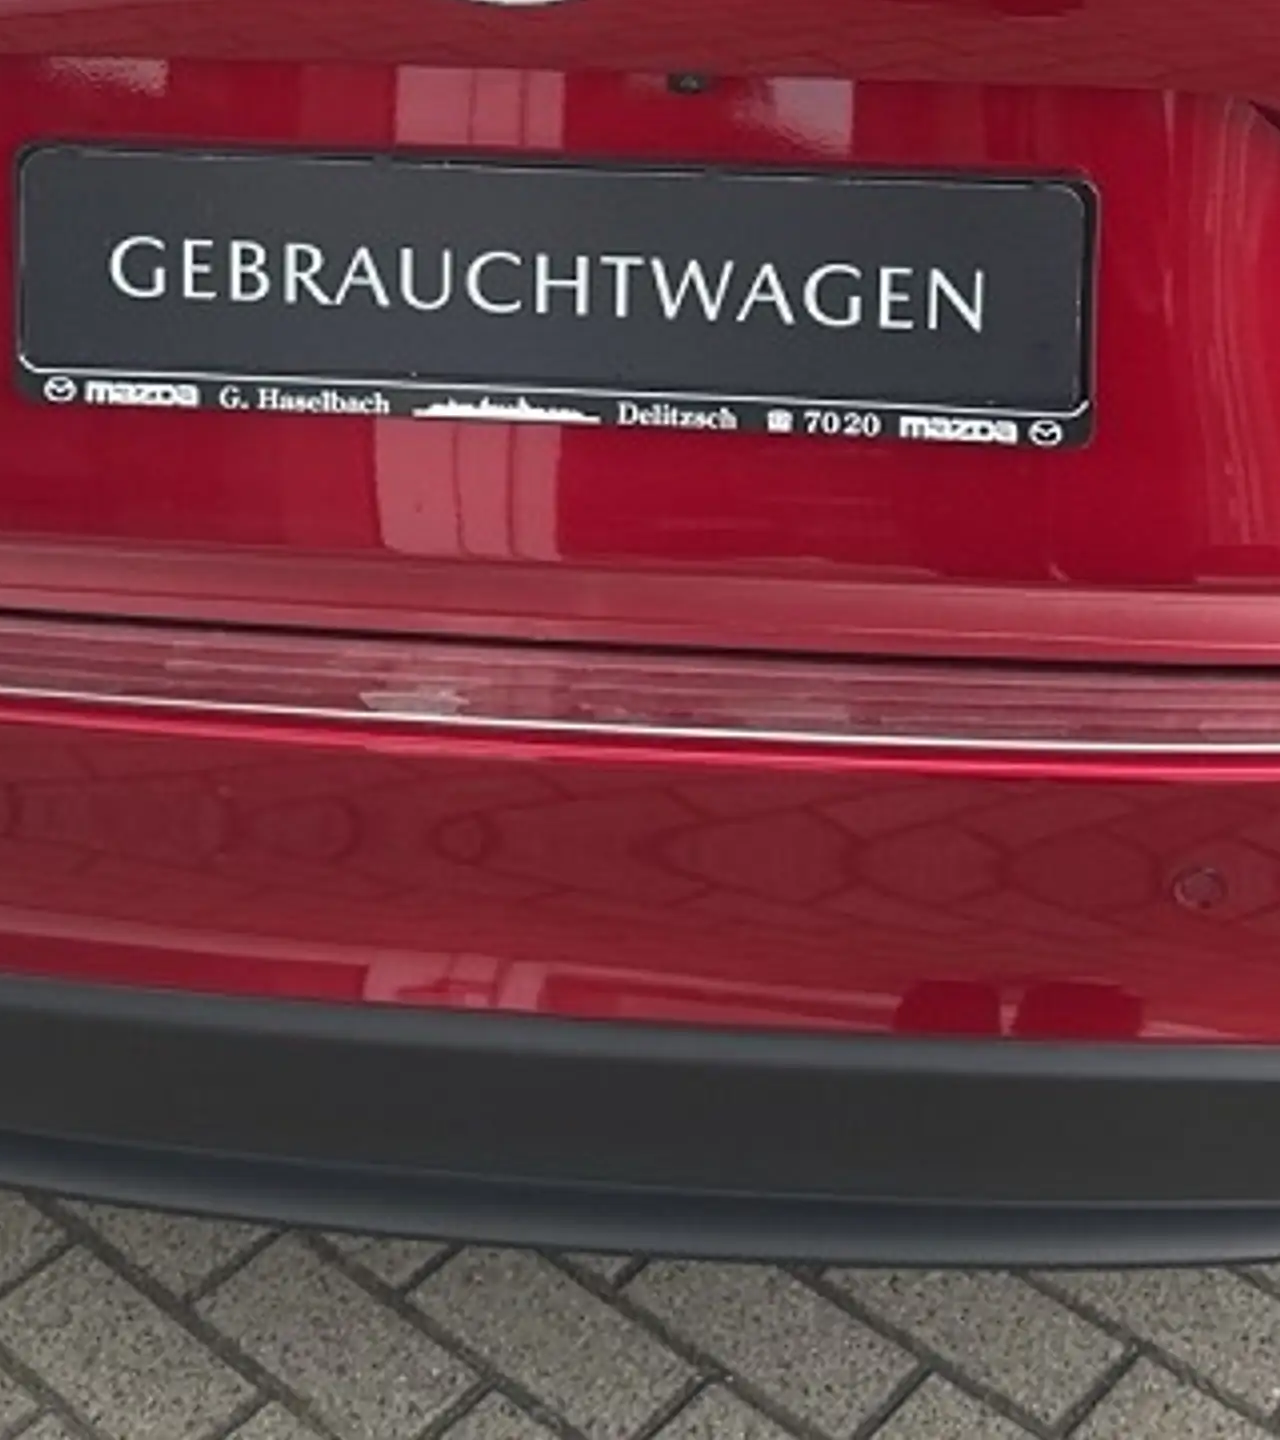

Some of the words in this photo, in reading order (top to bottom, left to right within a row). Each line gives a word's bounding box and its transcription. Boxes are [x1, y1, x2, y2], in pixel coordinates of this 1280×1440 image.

[110, 235, 984, 333] GEBRAUCHTWAGEN
[83, 380, 200, 408] mazda
[218, 386, 250, 410] G.
[257, 387, 391, 415] Haselbach
[617, 400, 738, 430] Delitzsch
[899, 415, 1019, 445] mazda
